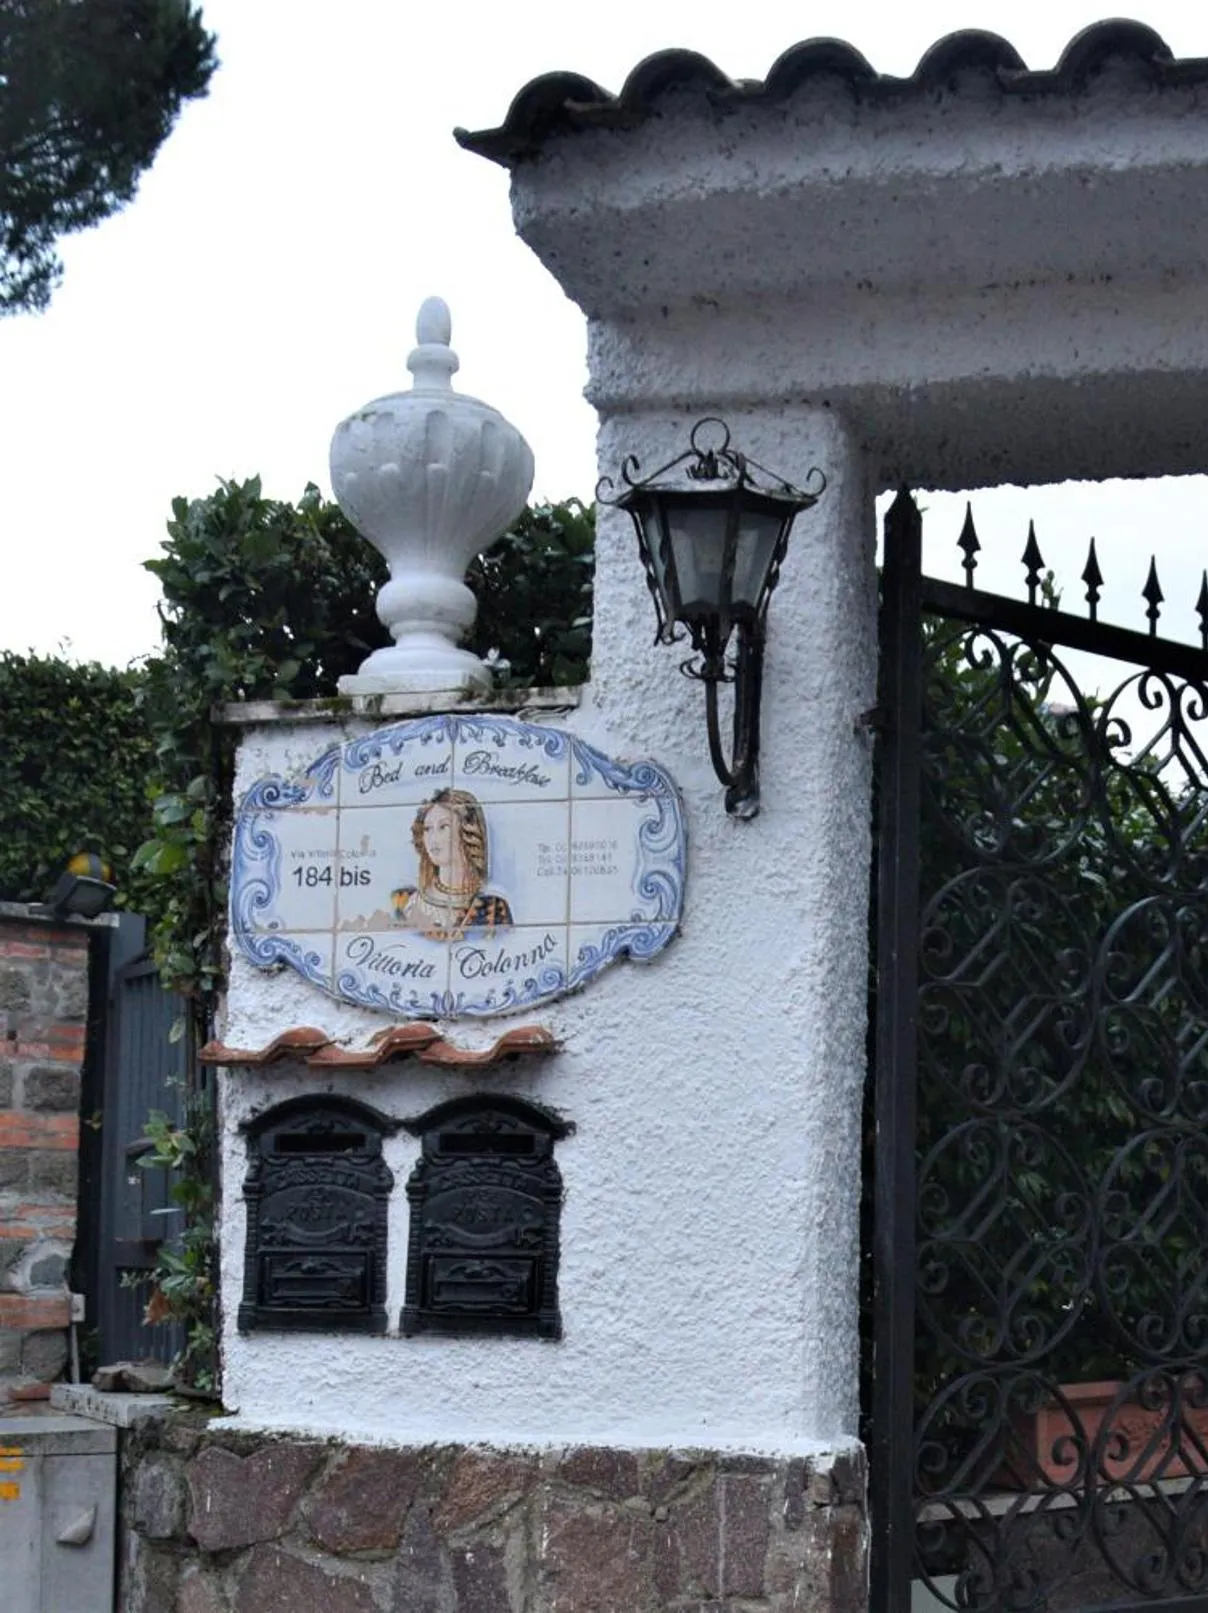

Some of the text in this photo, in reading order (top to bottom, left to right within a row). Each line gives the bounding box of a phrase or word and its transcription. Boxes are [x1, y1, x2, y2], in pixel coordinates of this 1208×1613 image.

[359, 761, 402, 794] Bed
[415, 754, 452, 777] and
[293, 866, 371, 887] 184 bis
[346, 934, 558, 979] Vittoria Colonna
